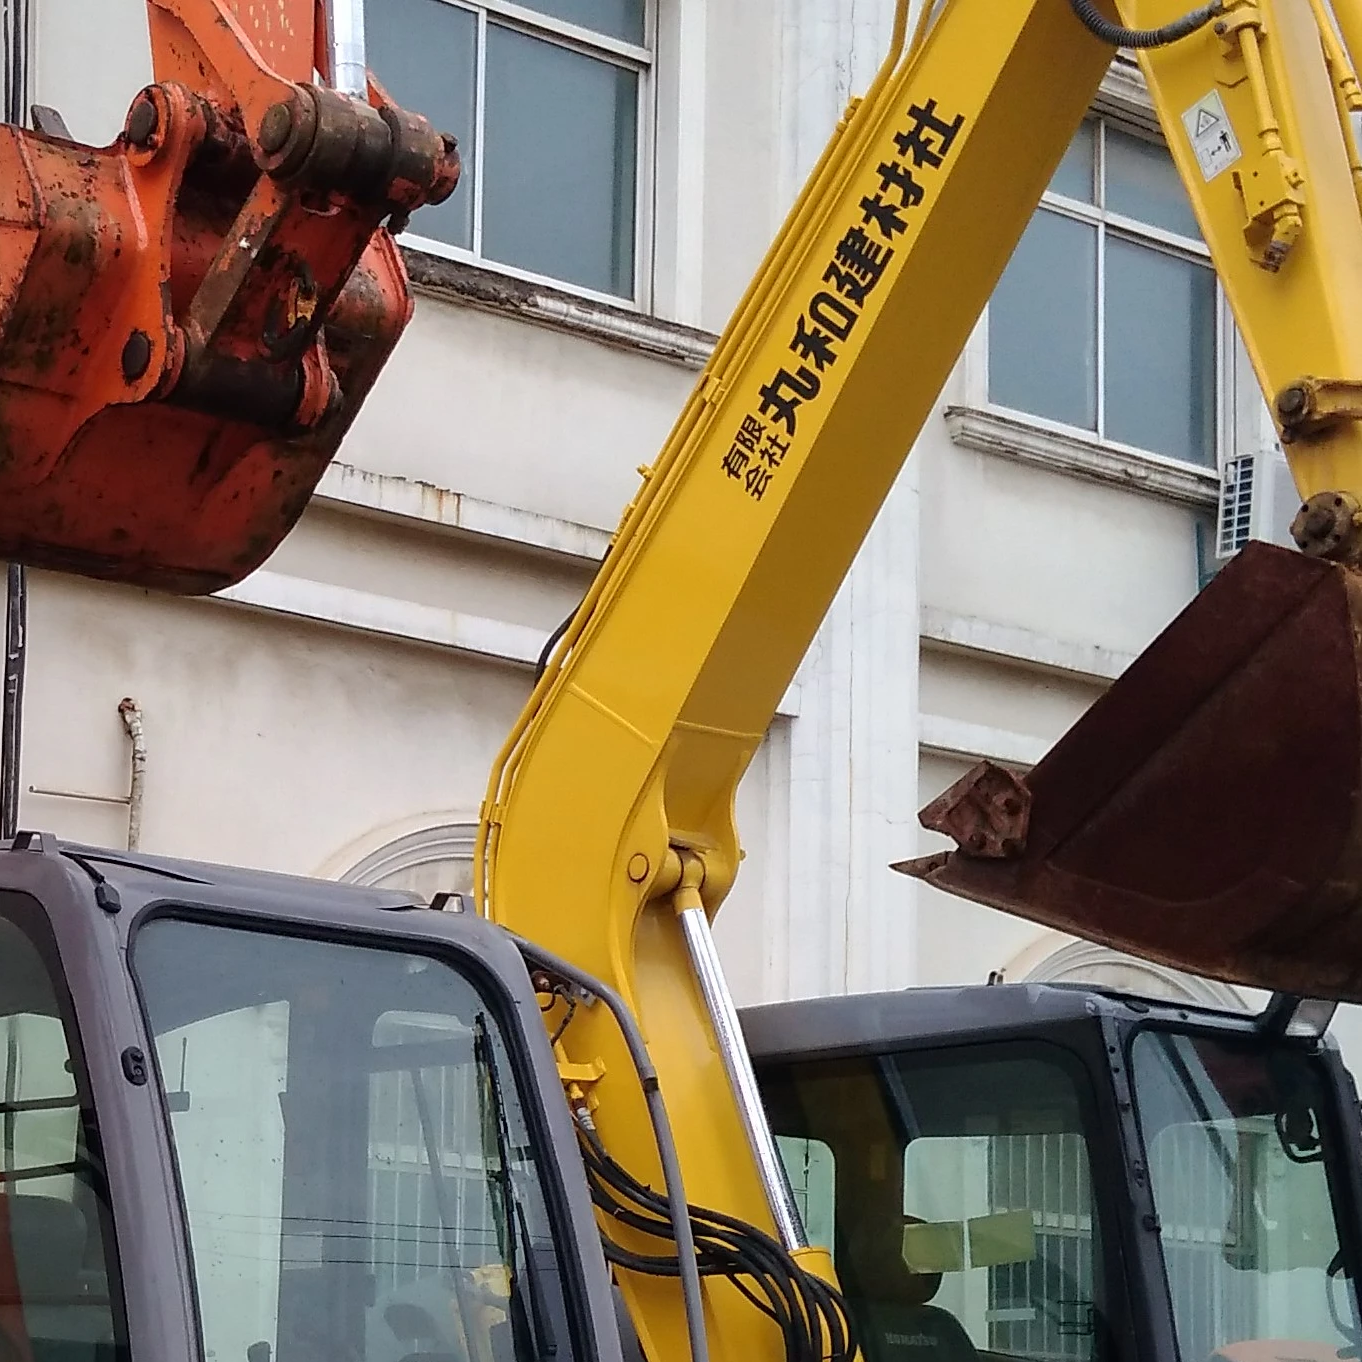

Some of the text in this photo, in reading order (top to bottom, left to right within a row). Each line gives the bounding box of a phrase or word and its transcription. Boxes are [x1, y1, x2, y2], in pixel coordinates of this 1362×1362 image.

[757, 98, 966, 437] 丸和建材社
